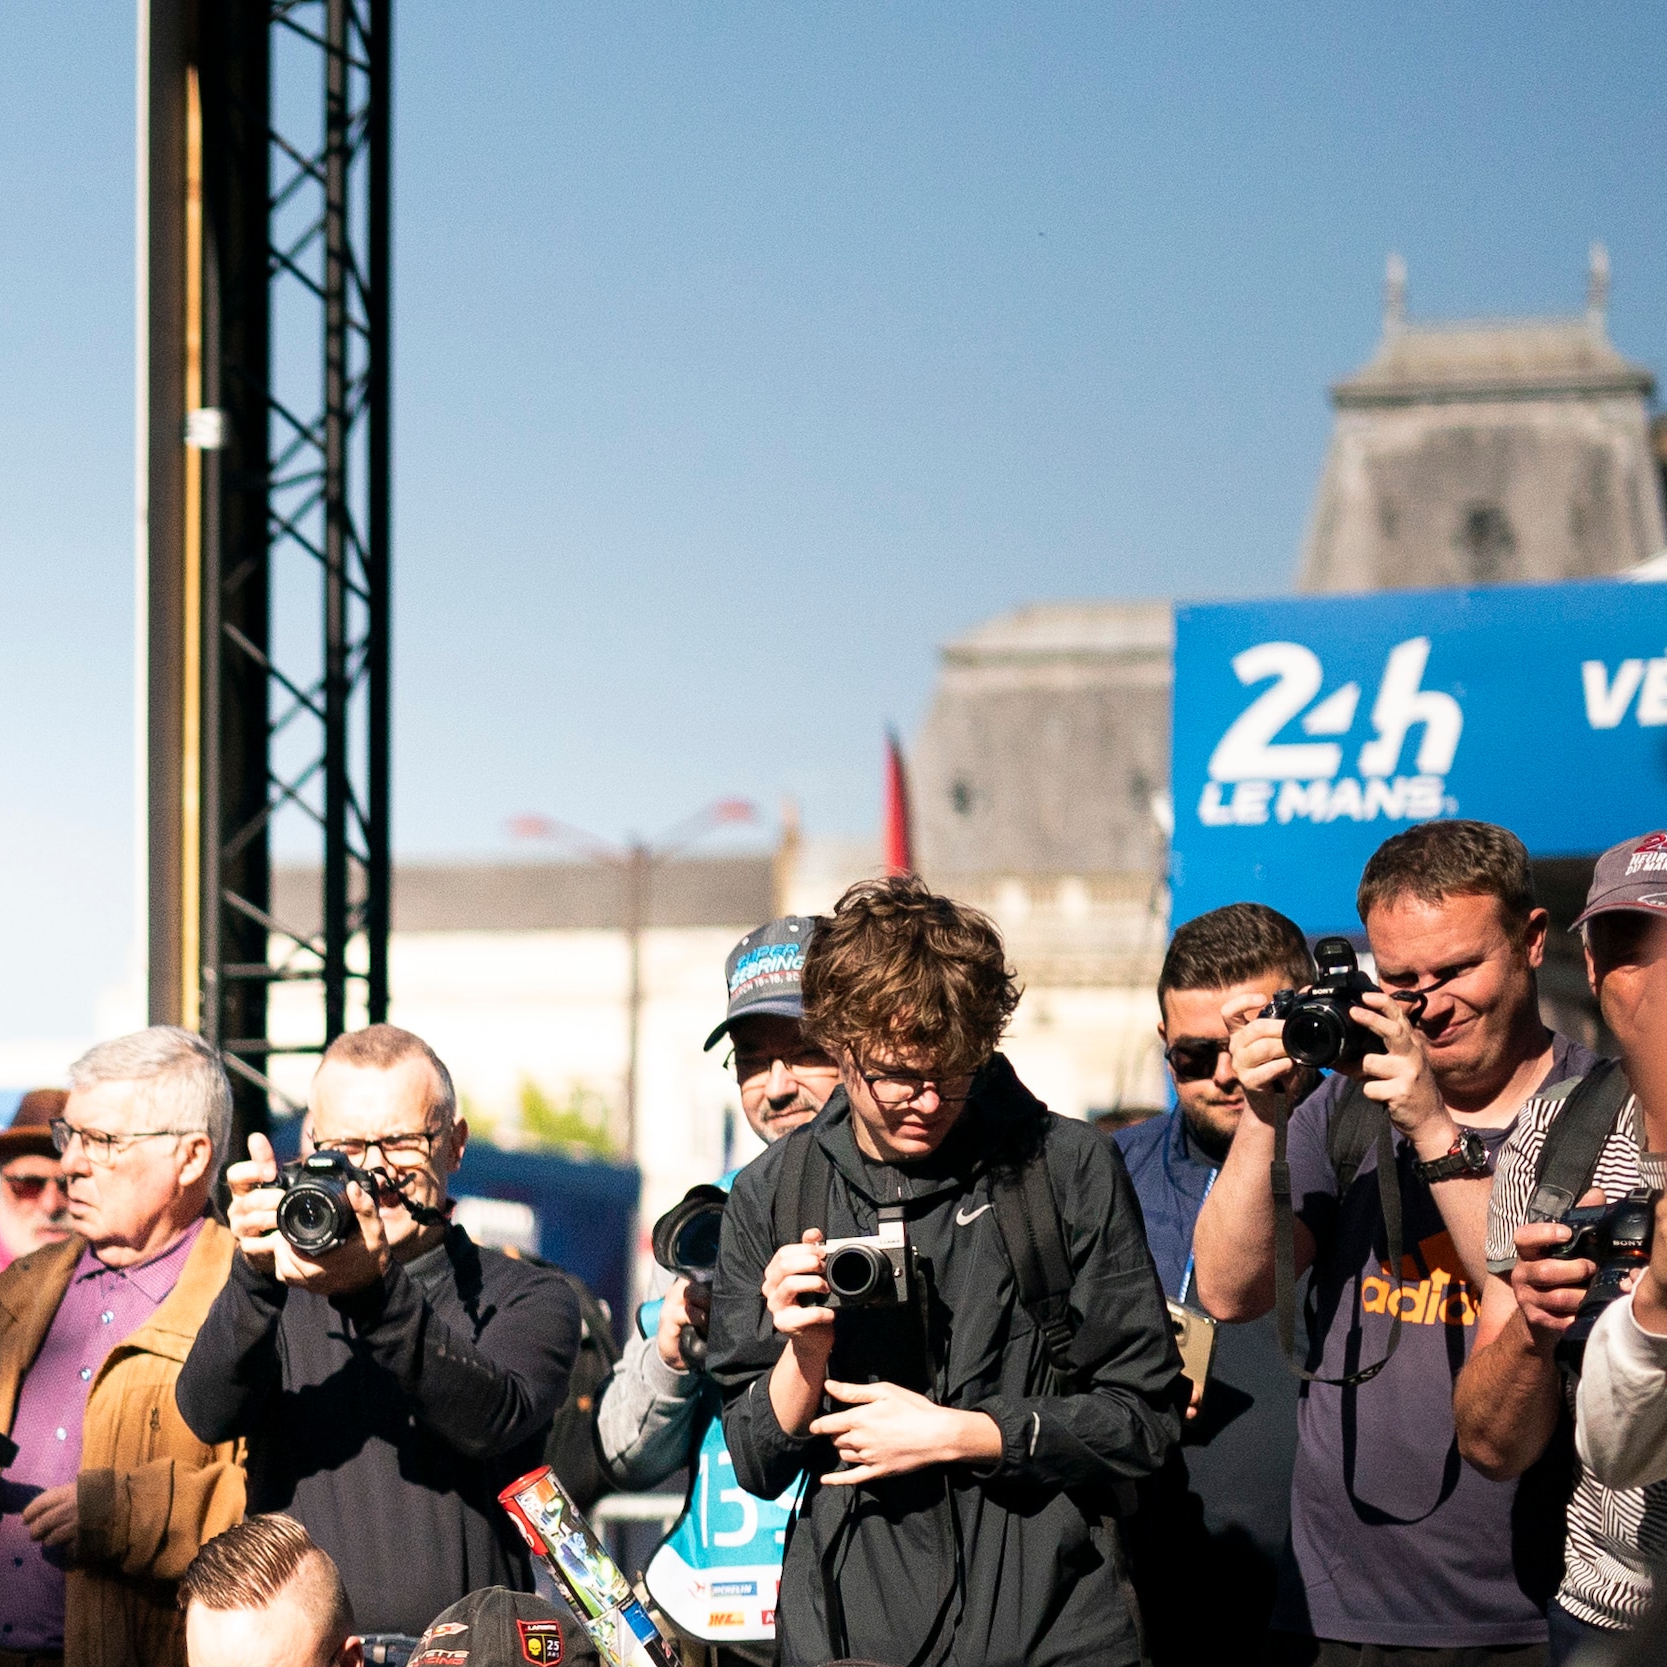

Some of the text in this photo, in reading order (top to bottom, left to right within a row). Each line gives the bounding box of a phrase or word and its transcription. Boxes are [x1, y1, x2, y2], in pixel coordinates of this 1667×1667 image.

[1208, 636, 1465, 782] 24h
[1198, 776, 1445, 826] LE MANS
[547, 1640, 560, 1651] 25
